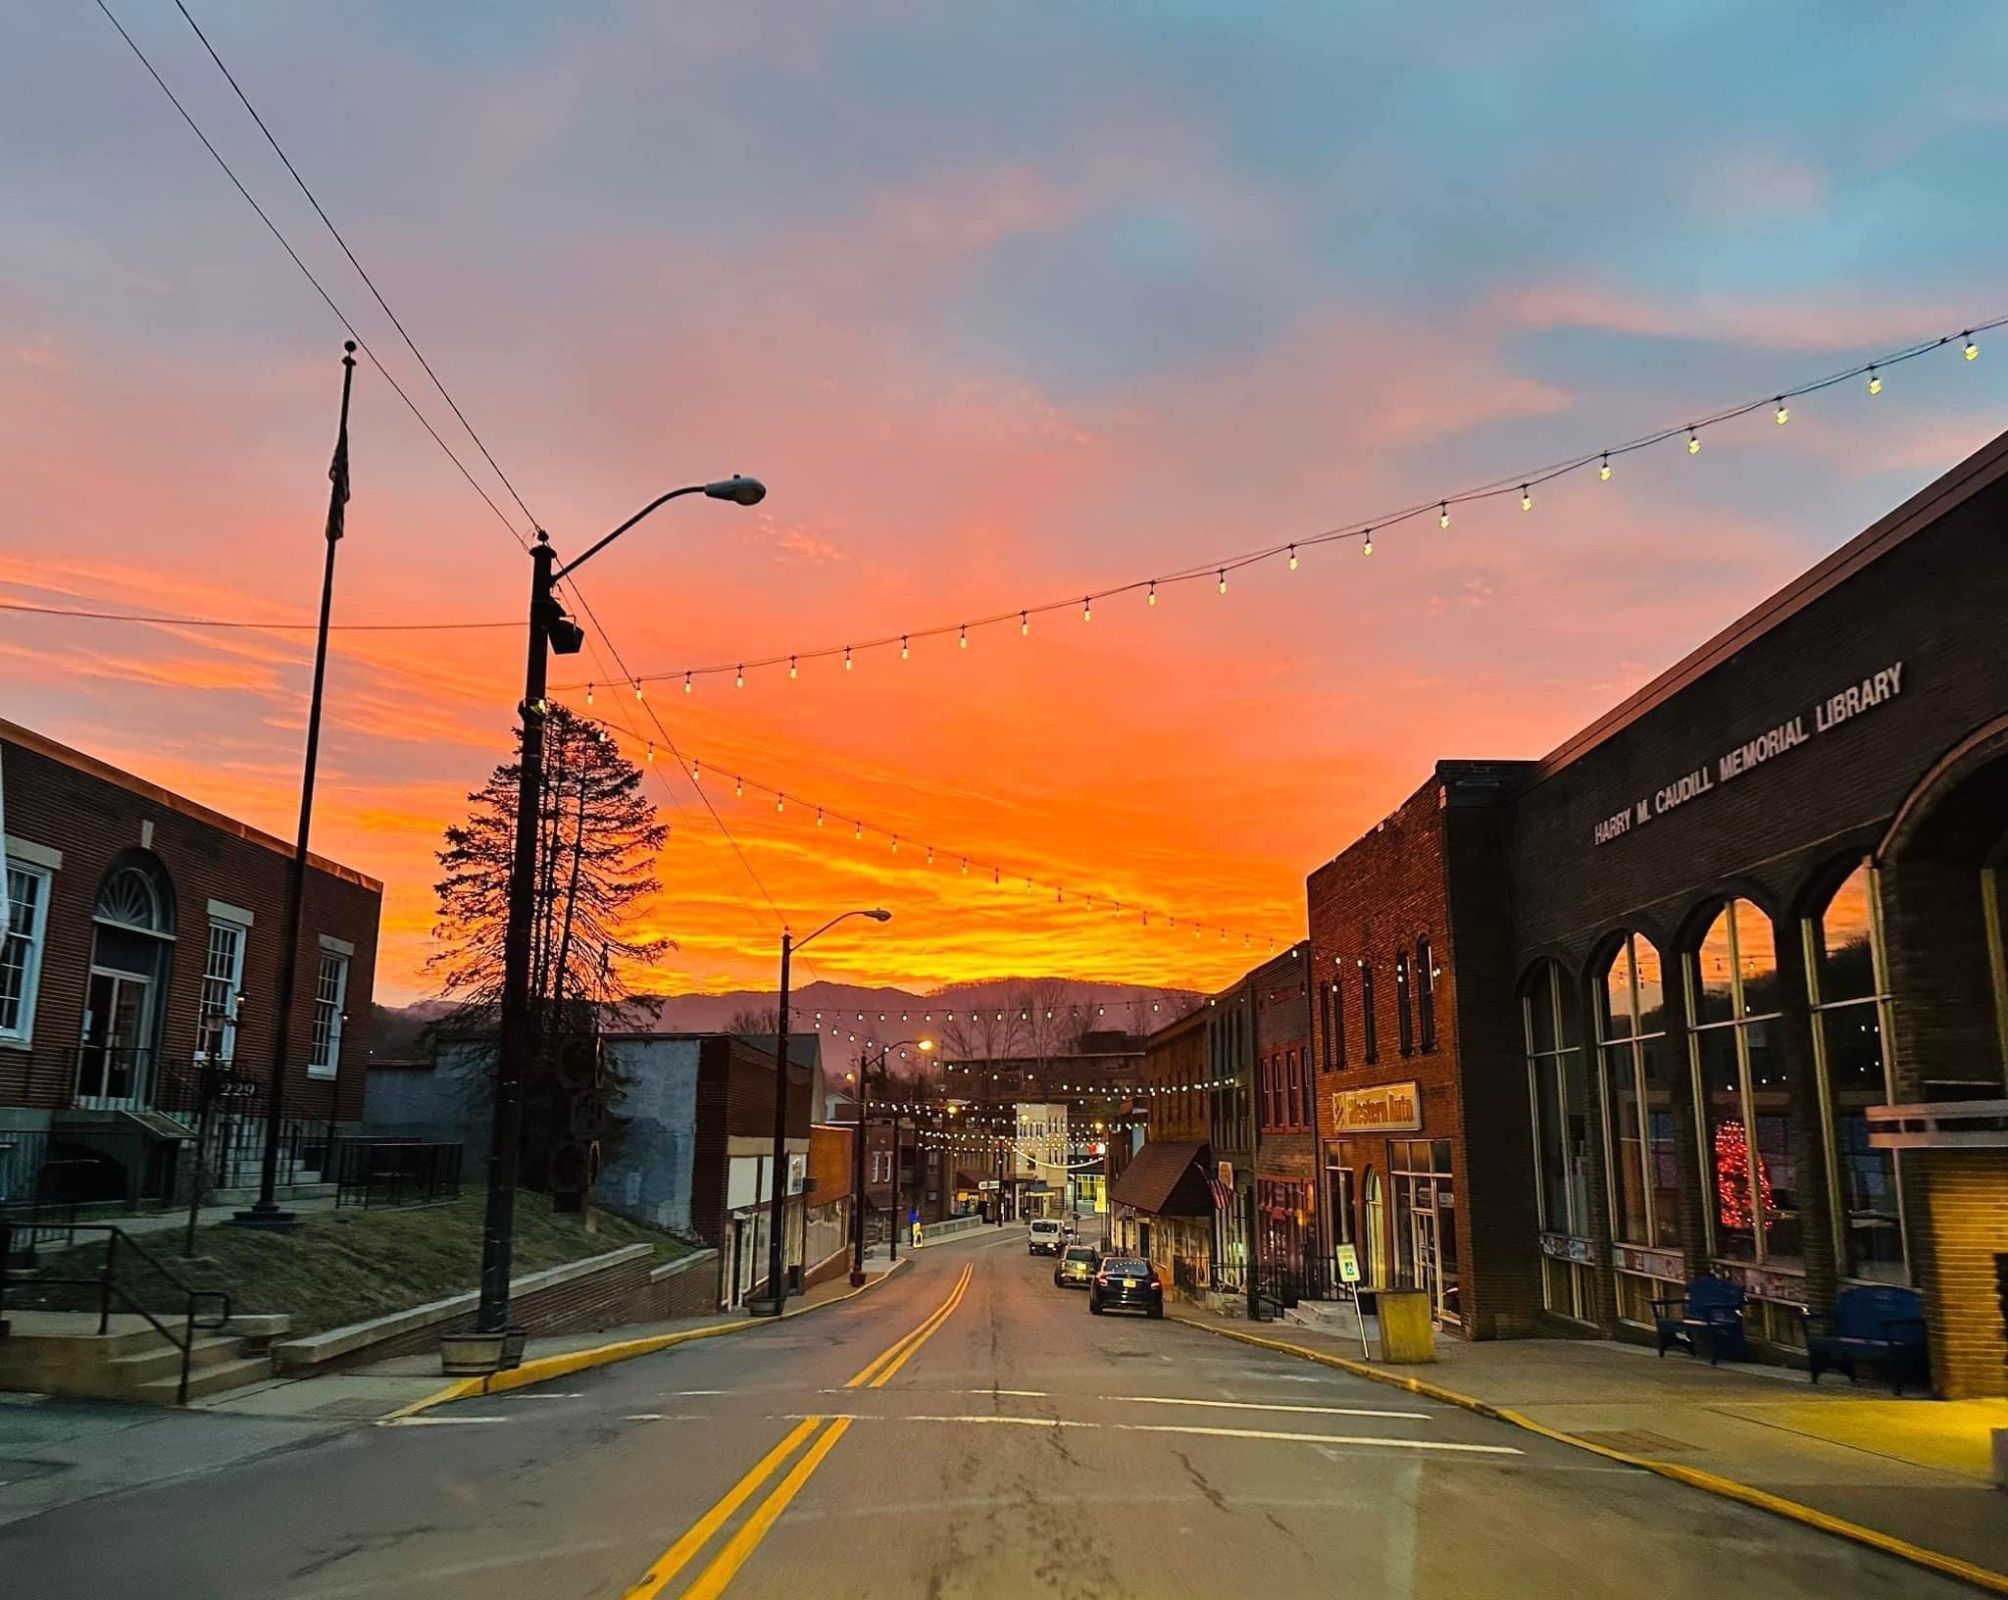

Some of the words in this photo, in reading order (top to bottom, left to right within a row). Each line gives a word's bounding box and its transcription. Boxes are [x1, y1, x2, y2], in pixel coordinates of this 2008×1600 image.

[1594, 807, 1631, 846] HARRY
[1636, 799, 1652, 825] M.
[1655, 766, 1714, 814] CAUDILL
[1719, 716, 1810, 782] MEMORIAL
[1816, 661, 1902, 733] LIBRARY
[219, 1082, 255, 1097] 229
